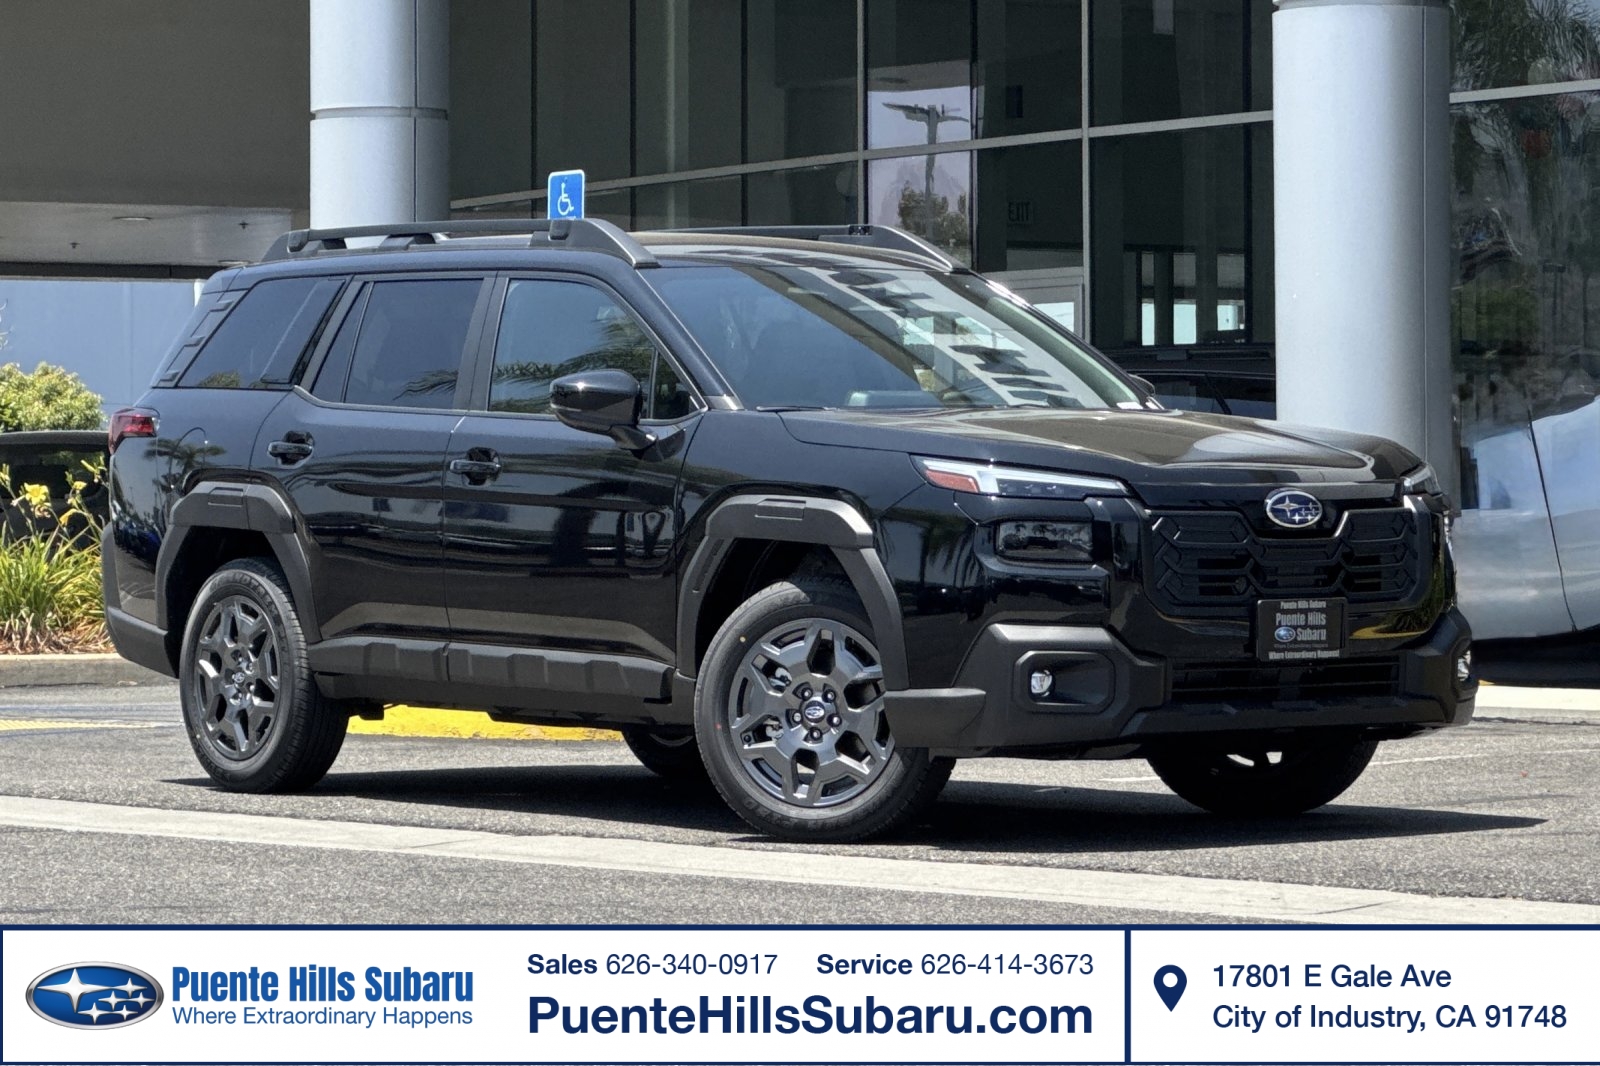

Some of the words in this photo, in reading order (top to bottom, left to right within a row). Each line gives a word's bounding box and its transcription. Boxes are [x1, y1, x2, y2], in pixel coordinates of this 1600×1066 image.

[1275, 612, 1306, 626] Puente
[1307, 611, 1327, 626] Hills
[1296, 627, 1327, 641] Subaru
